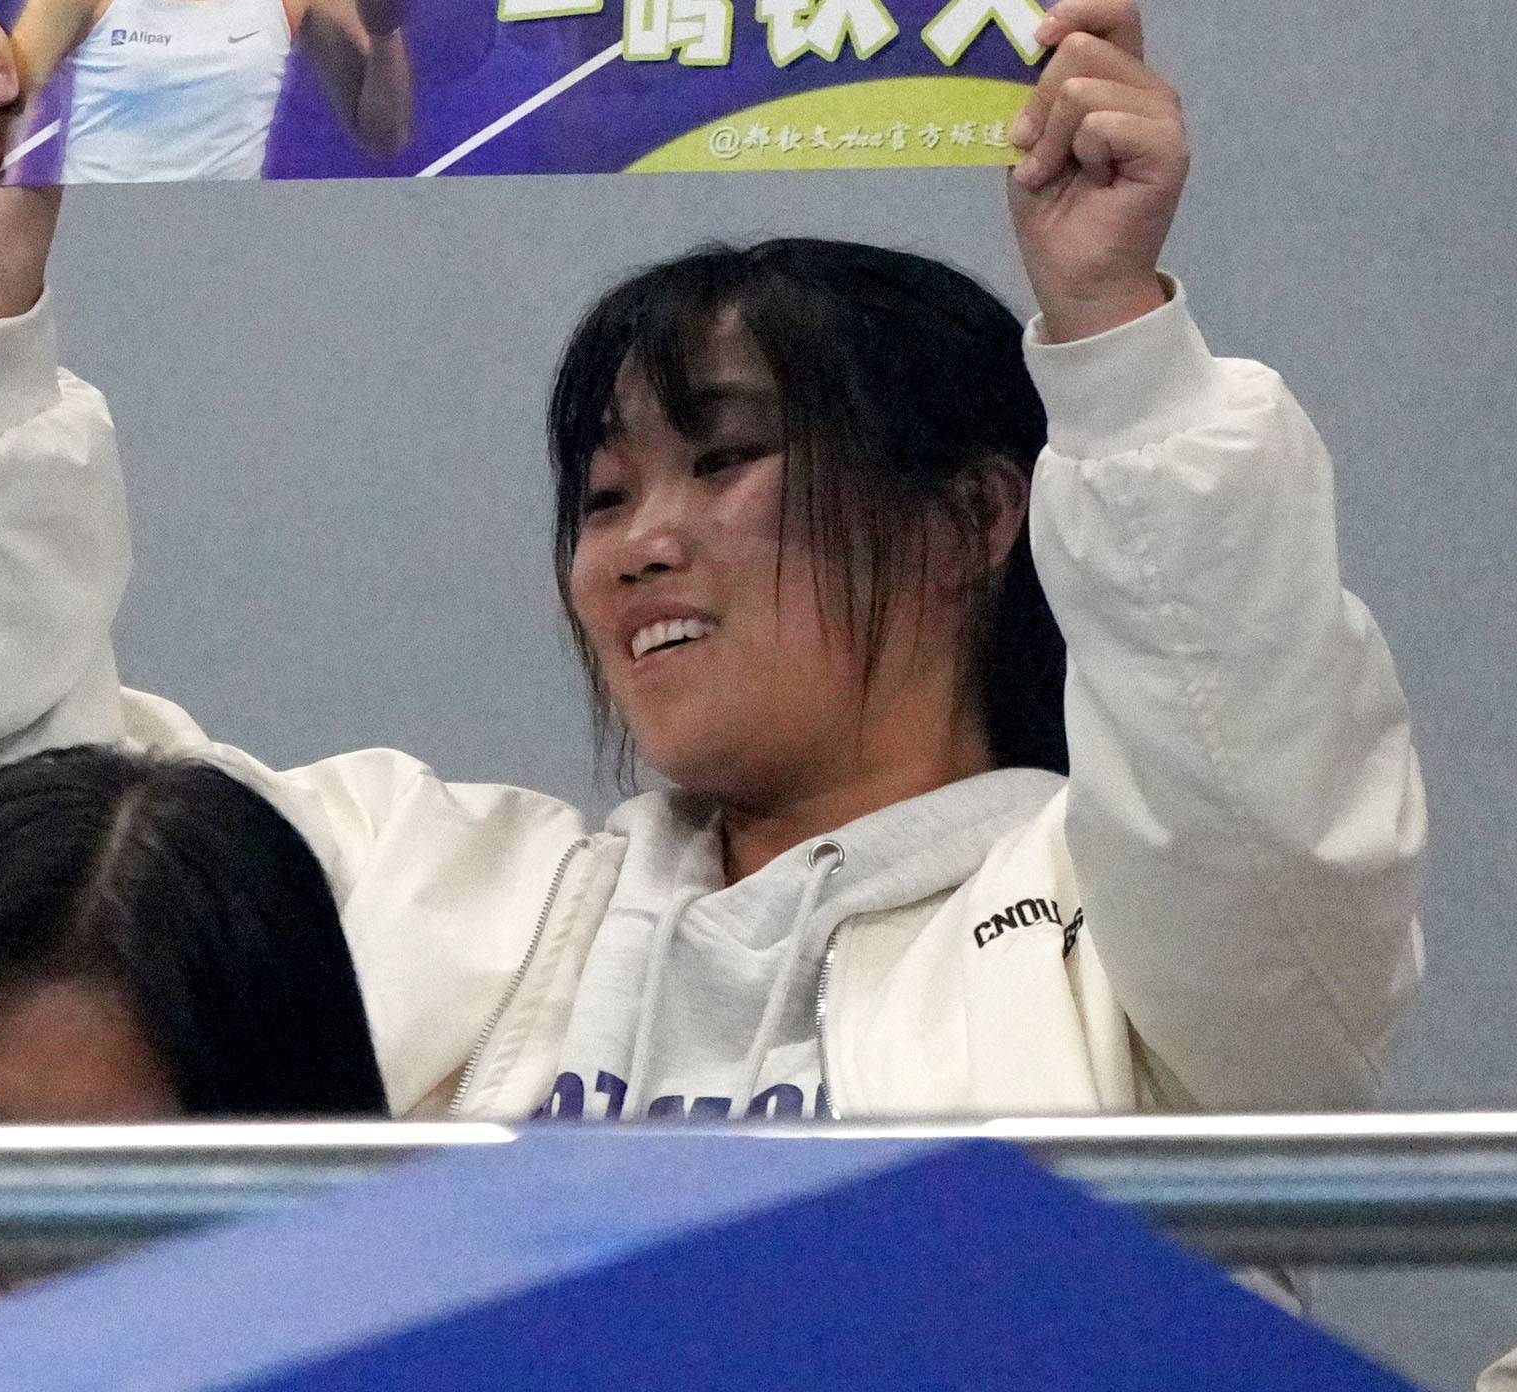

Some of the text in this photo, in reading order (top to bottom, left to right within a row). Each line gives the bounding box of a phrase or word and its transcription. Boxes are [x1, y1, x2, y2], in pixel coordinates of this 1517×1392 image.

[128, 31, 173, 46] Alipay
[708, 121, 1010, 160] @郑钦文Ana官方球迷
